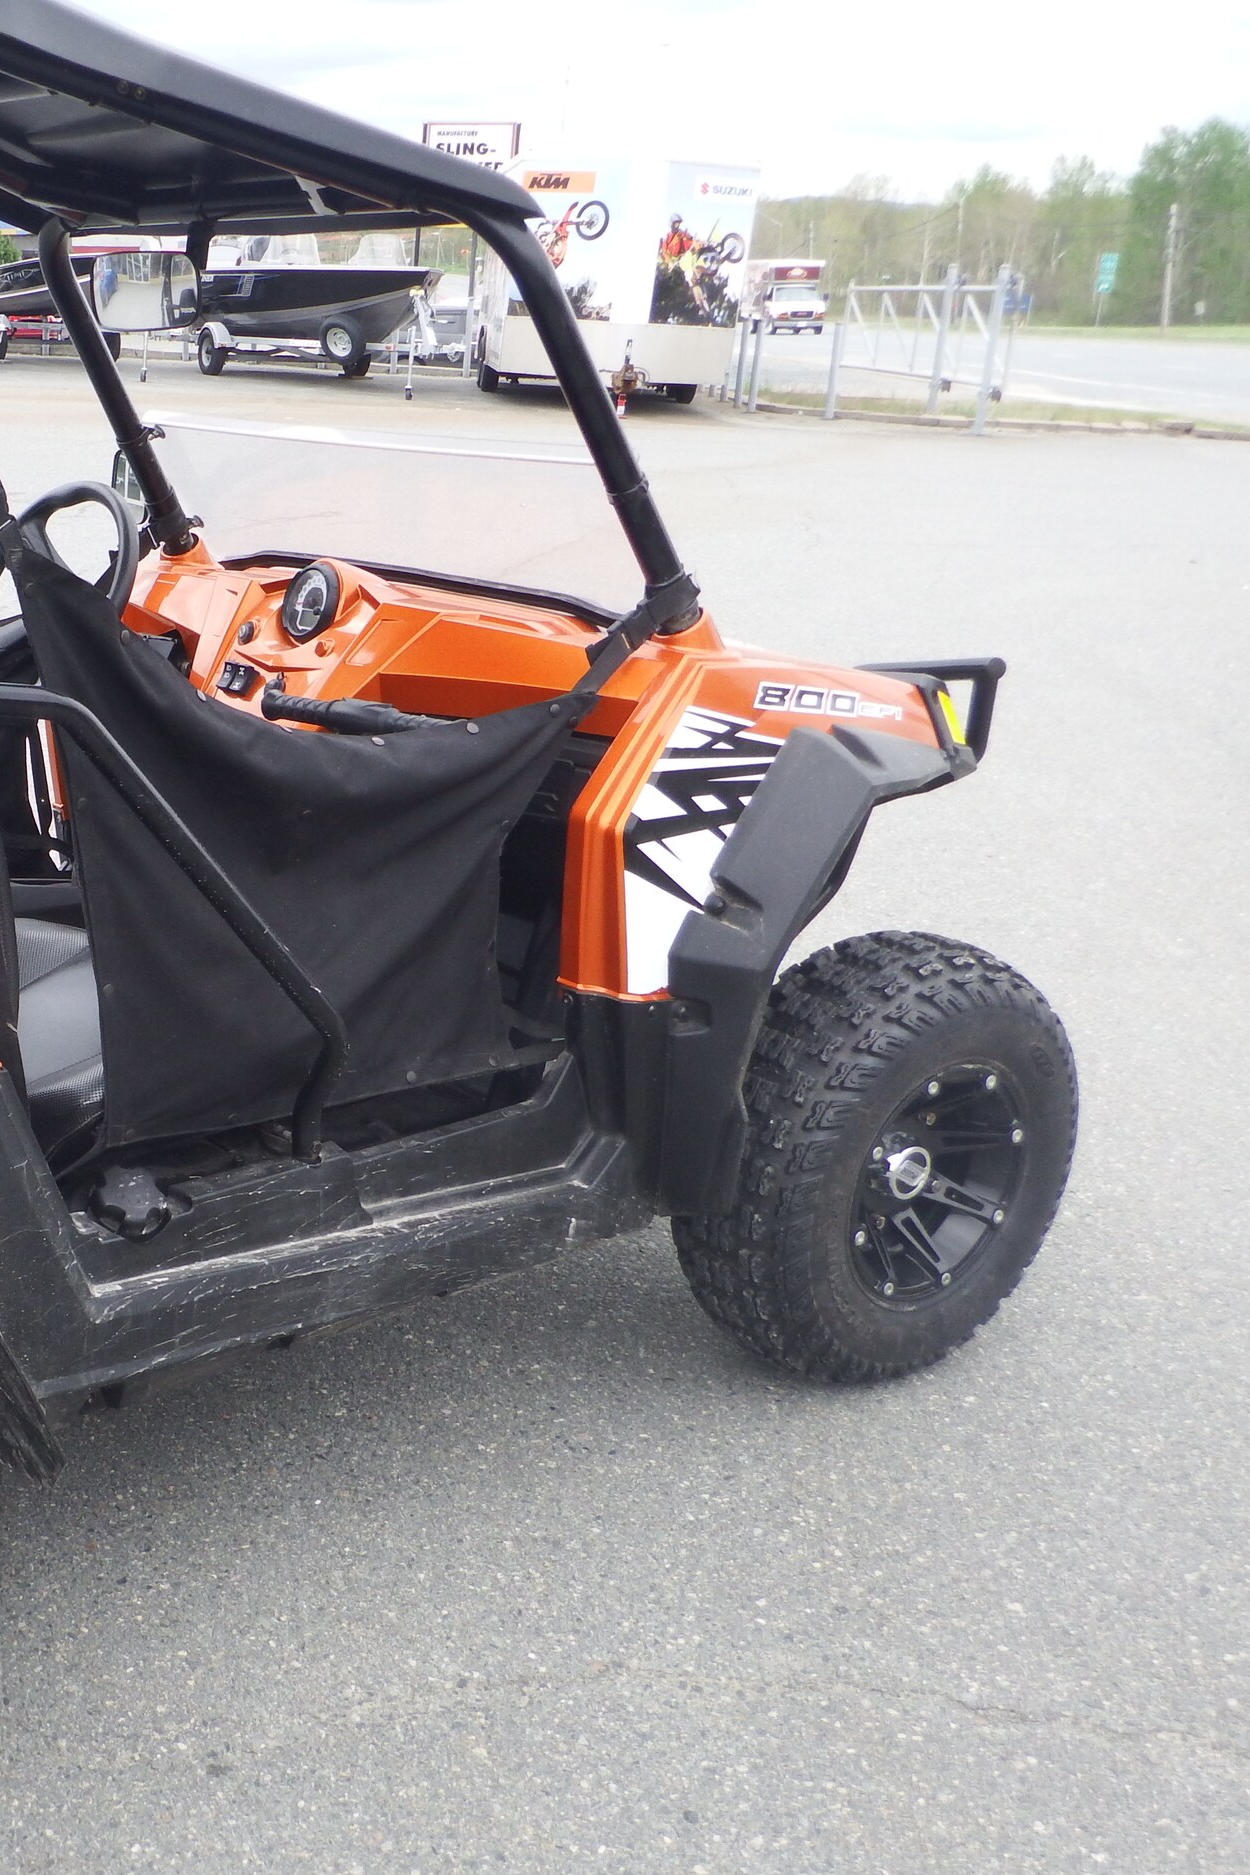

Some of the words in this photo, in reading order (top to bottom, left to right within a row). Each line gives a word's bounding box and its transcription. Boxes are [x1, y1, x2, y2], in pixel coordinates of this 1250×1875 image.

[528, 173, 571, 189] KTM
[712, 184, 753, 198] SUZUKI
[755, 682, 858, 717] 800
